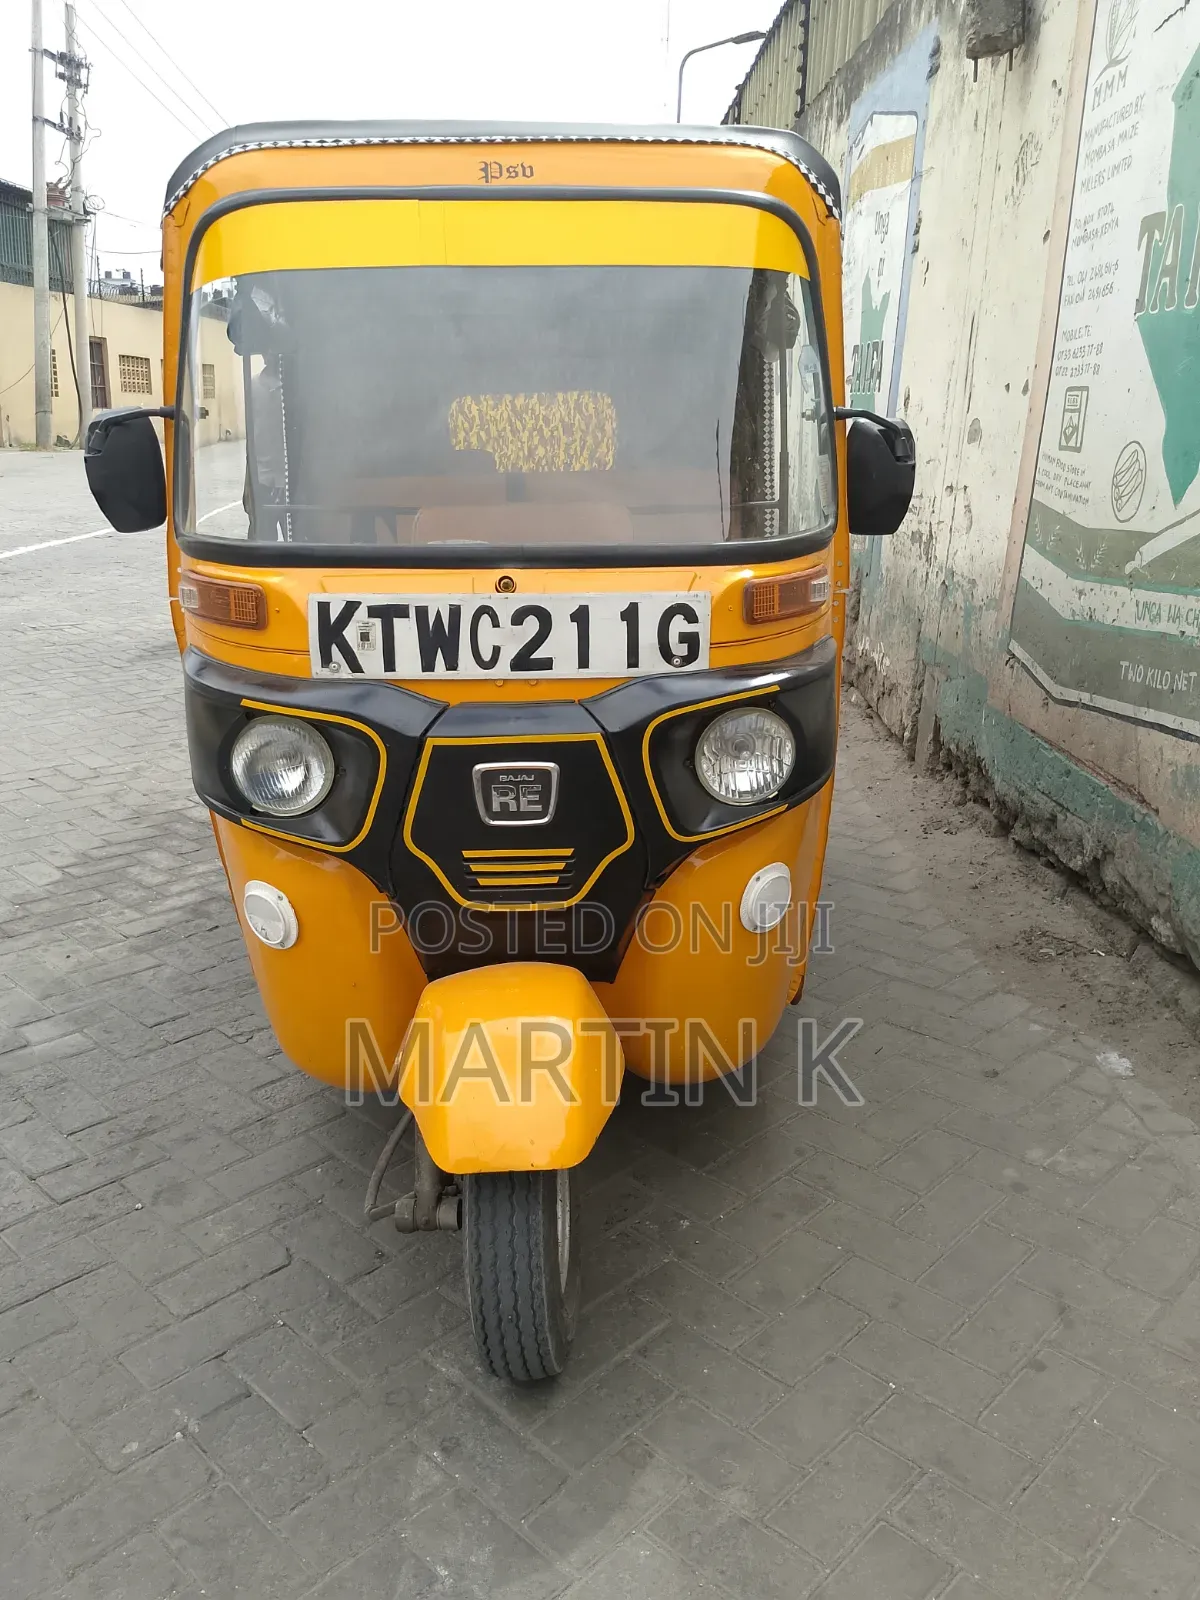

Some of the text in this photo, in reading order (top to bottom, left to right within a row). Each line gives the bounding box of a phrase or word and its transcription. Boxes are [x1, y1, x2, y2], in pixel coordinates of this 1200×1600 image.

[477, 160, 535, 184] Psv
[316, 599, 702, 675] KTWC211G
[1119, 660, 1197, 694] TWO KILO NET
[499, 774, 535, 782] BAJAJ
[491, 784, 543, 812] RE
